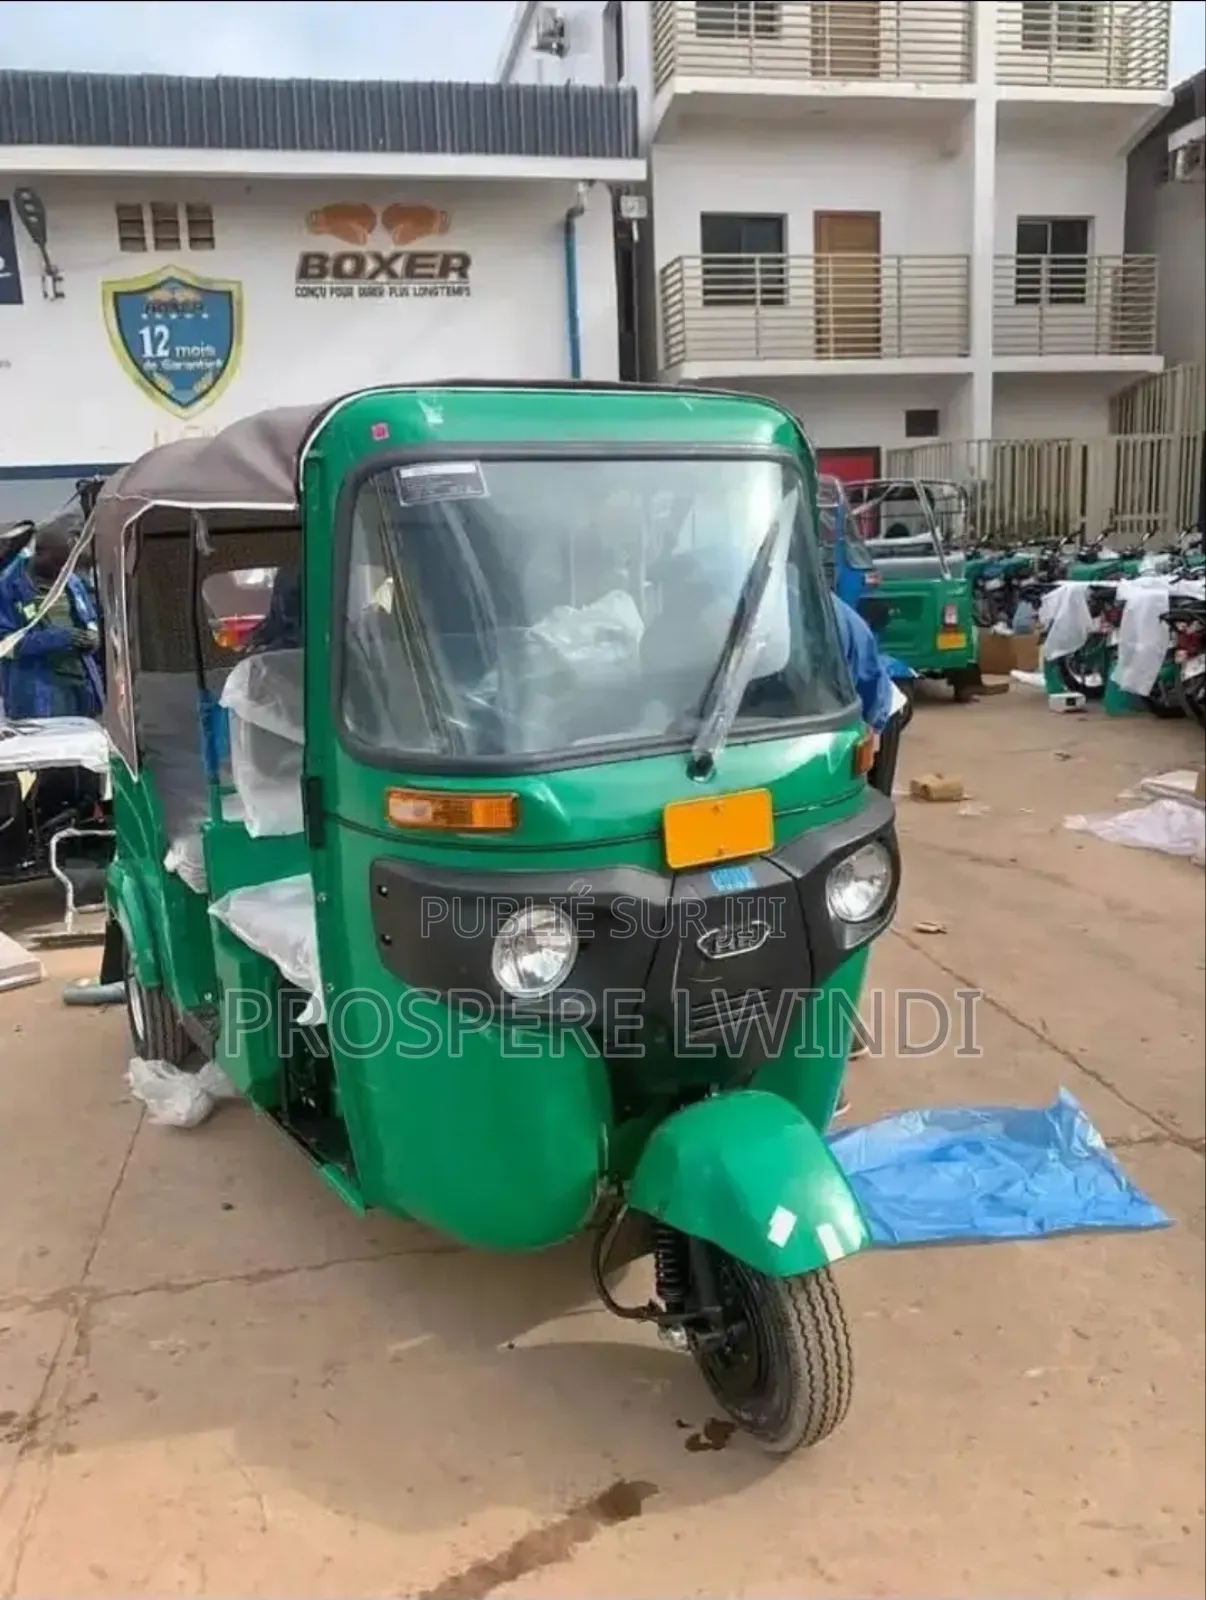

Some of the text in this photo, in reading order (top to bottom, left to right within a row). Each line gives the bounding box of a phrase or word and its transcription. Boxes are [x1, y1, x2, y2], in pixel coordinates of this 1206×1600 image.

[296, 251, 472, 279] BOXER
[329, 286, 354, 297] POUR
[389, 286, 411, 297] PLUS
[413, 286, 471, 297] LONGTEMPS
[139, 324, 216, 357] 12 mois
